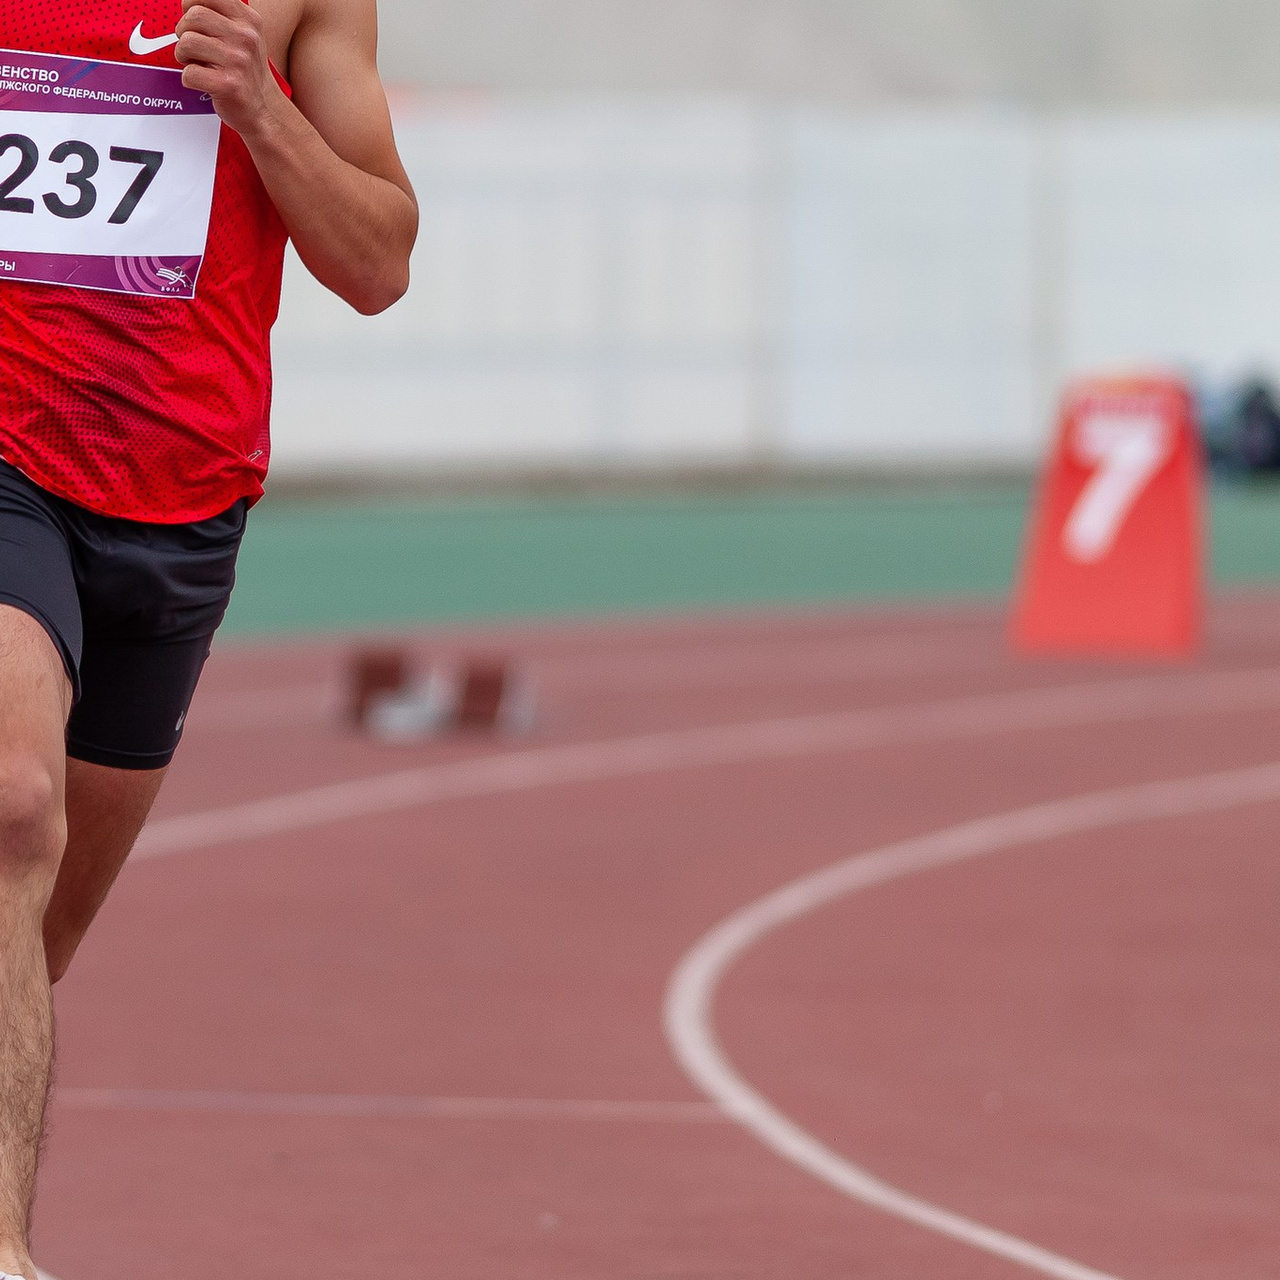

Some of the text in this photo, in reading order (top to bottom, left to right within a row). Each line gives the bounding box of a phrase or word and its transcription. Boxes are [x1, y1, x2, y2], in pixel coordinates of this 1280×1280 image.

[52, 86, 141, 105] ФЕДЕРАЛЬНОГО
[142, 96, 183, 111] ОКРУГА
[1061, 412, 1172, 564] 7
